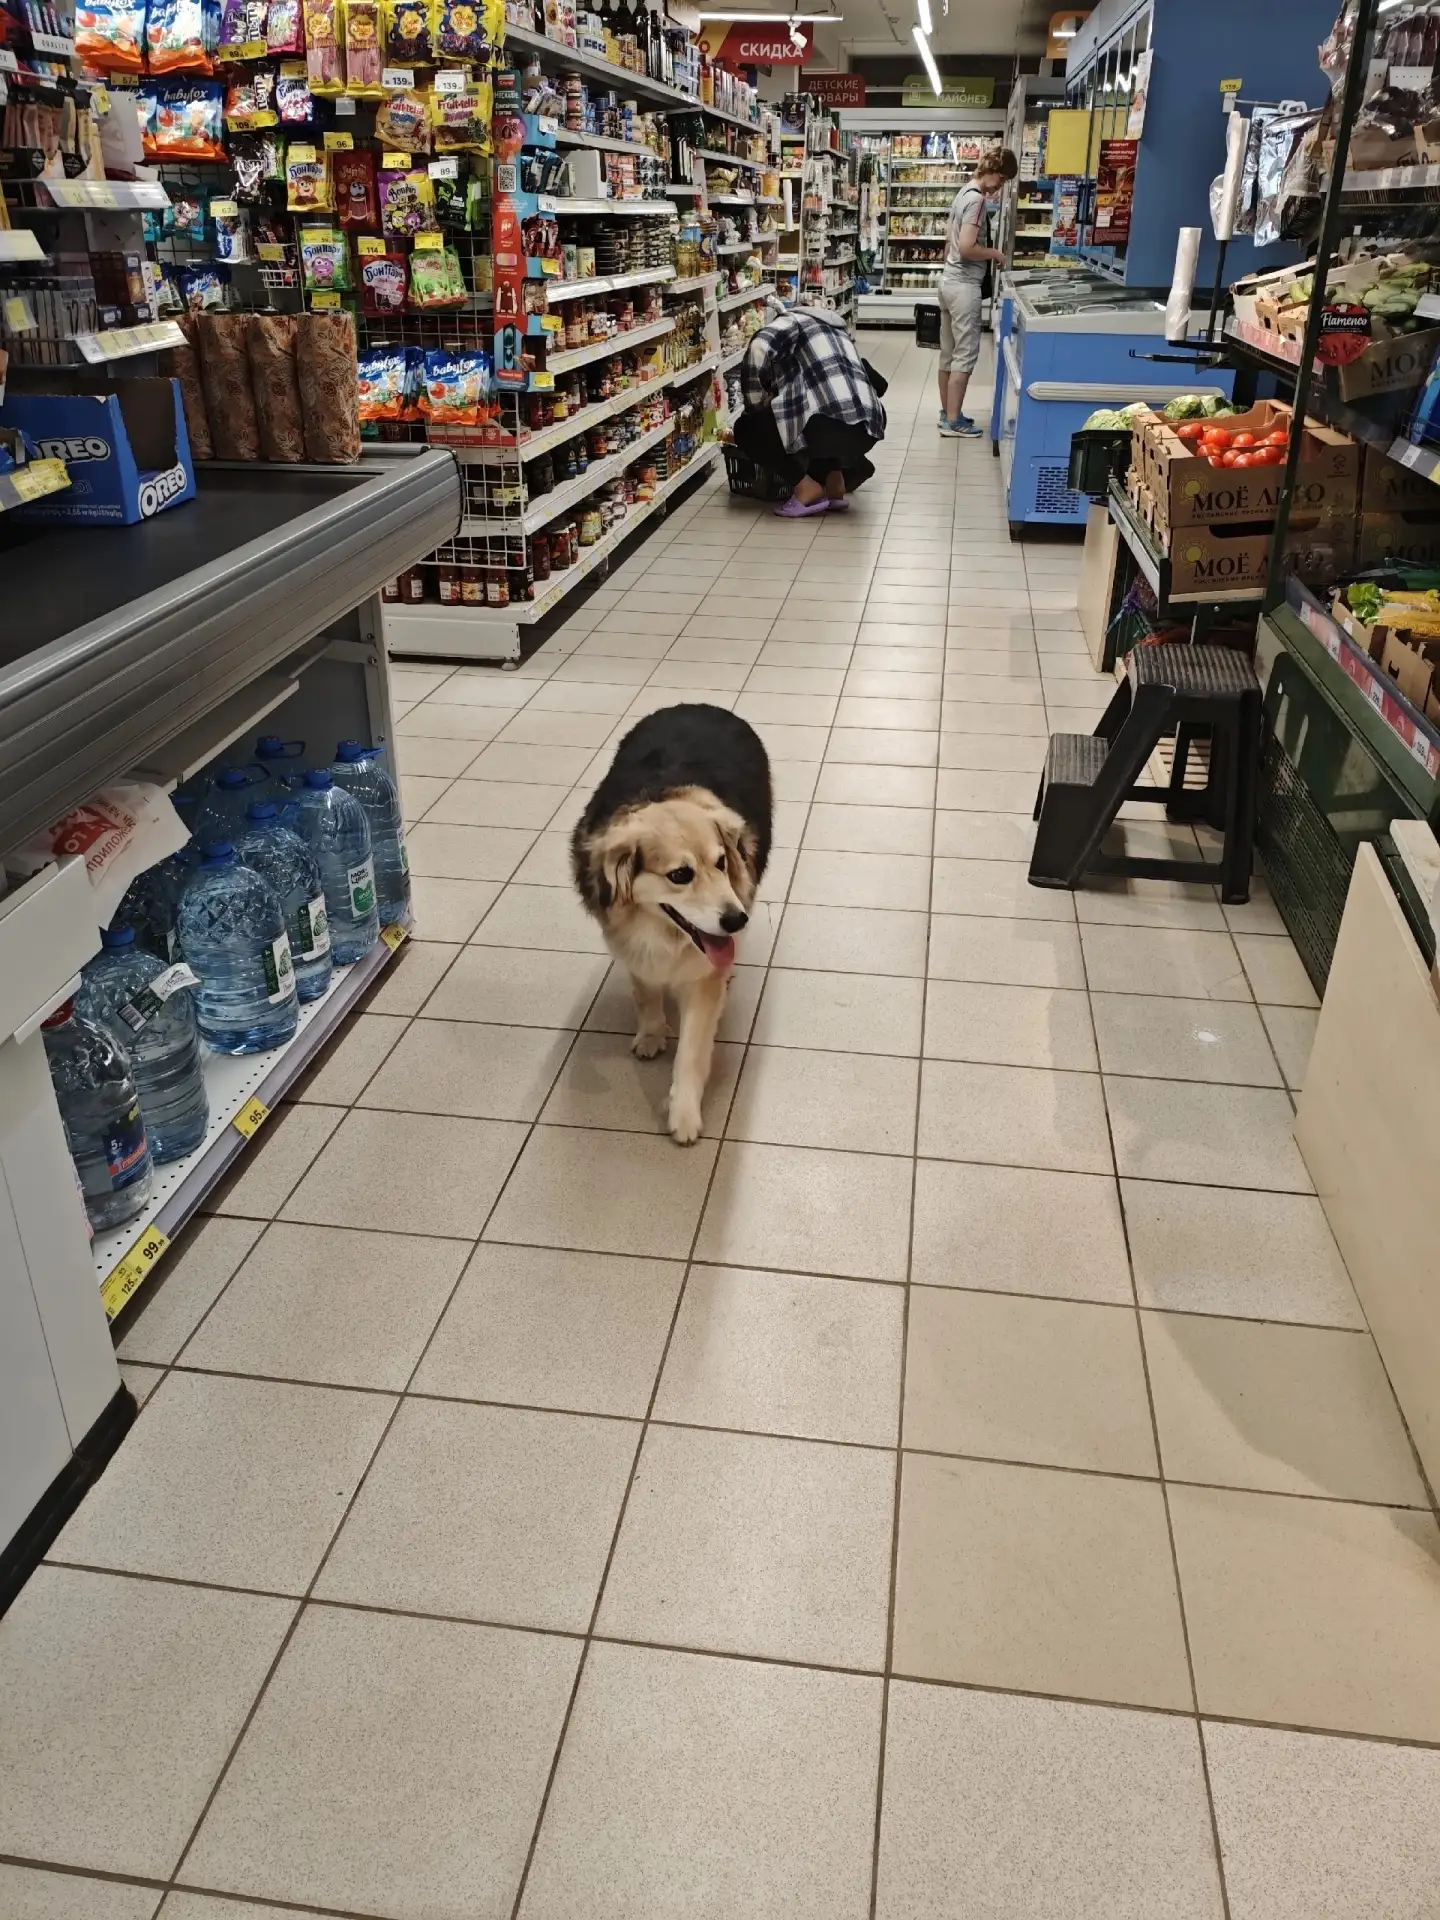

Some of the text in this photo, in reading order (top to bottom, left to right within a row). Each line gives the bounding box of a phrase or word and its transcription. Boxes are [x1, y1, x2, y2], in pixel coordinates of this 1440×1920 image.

[739, 42, 804, 59] СКИДКА
[392, 77, 407, 85] 139
[442, 82, 457, 90] 139
[808, 79, 859, 91] ДЕТСКИЕ
[163, 87, 209, 102] babyfox
[437, 97, 479, 110] Fruit-tella
[1320, 311, 1368, 328] Flamenco
[432, 357, 477, 377] babyfox
[139, 467, 188, 518] OREO
[1192, 486, 1249, 513] МОЁ
[1193, 552, 1250, 578] МОЁ
[249, 1109, 263, 1125] 95
[142, 1241, 159, 1260] 99
[121, 1279, 135, 1295] 125
